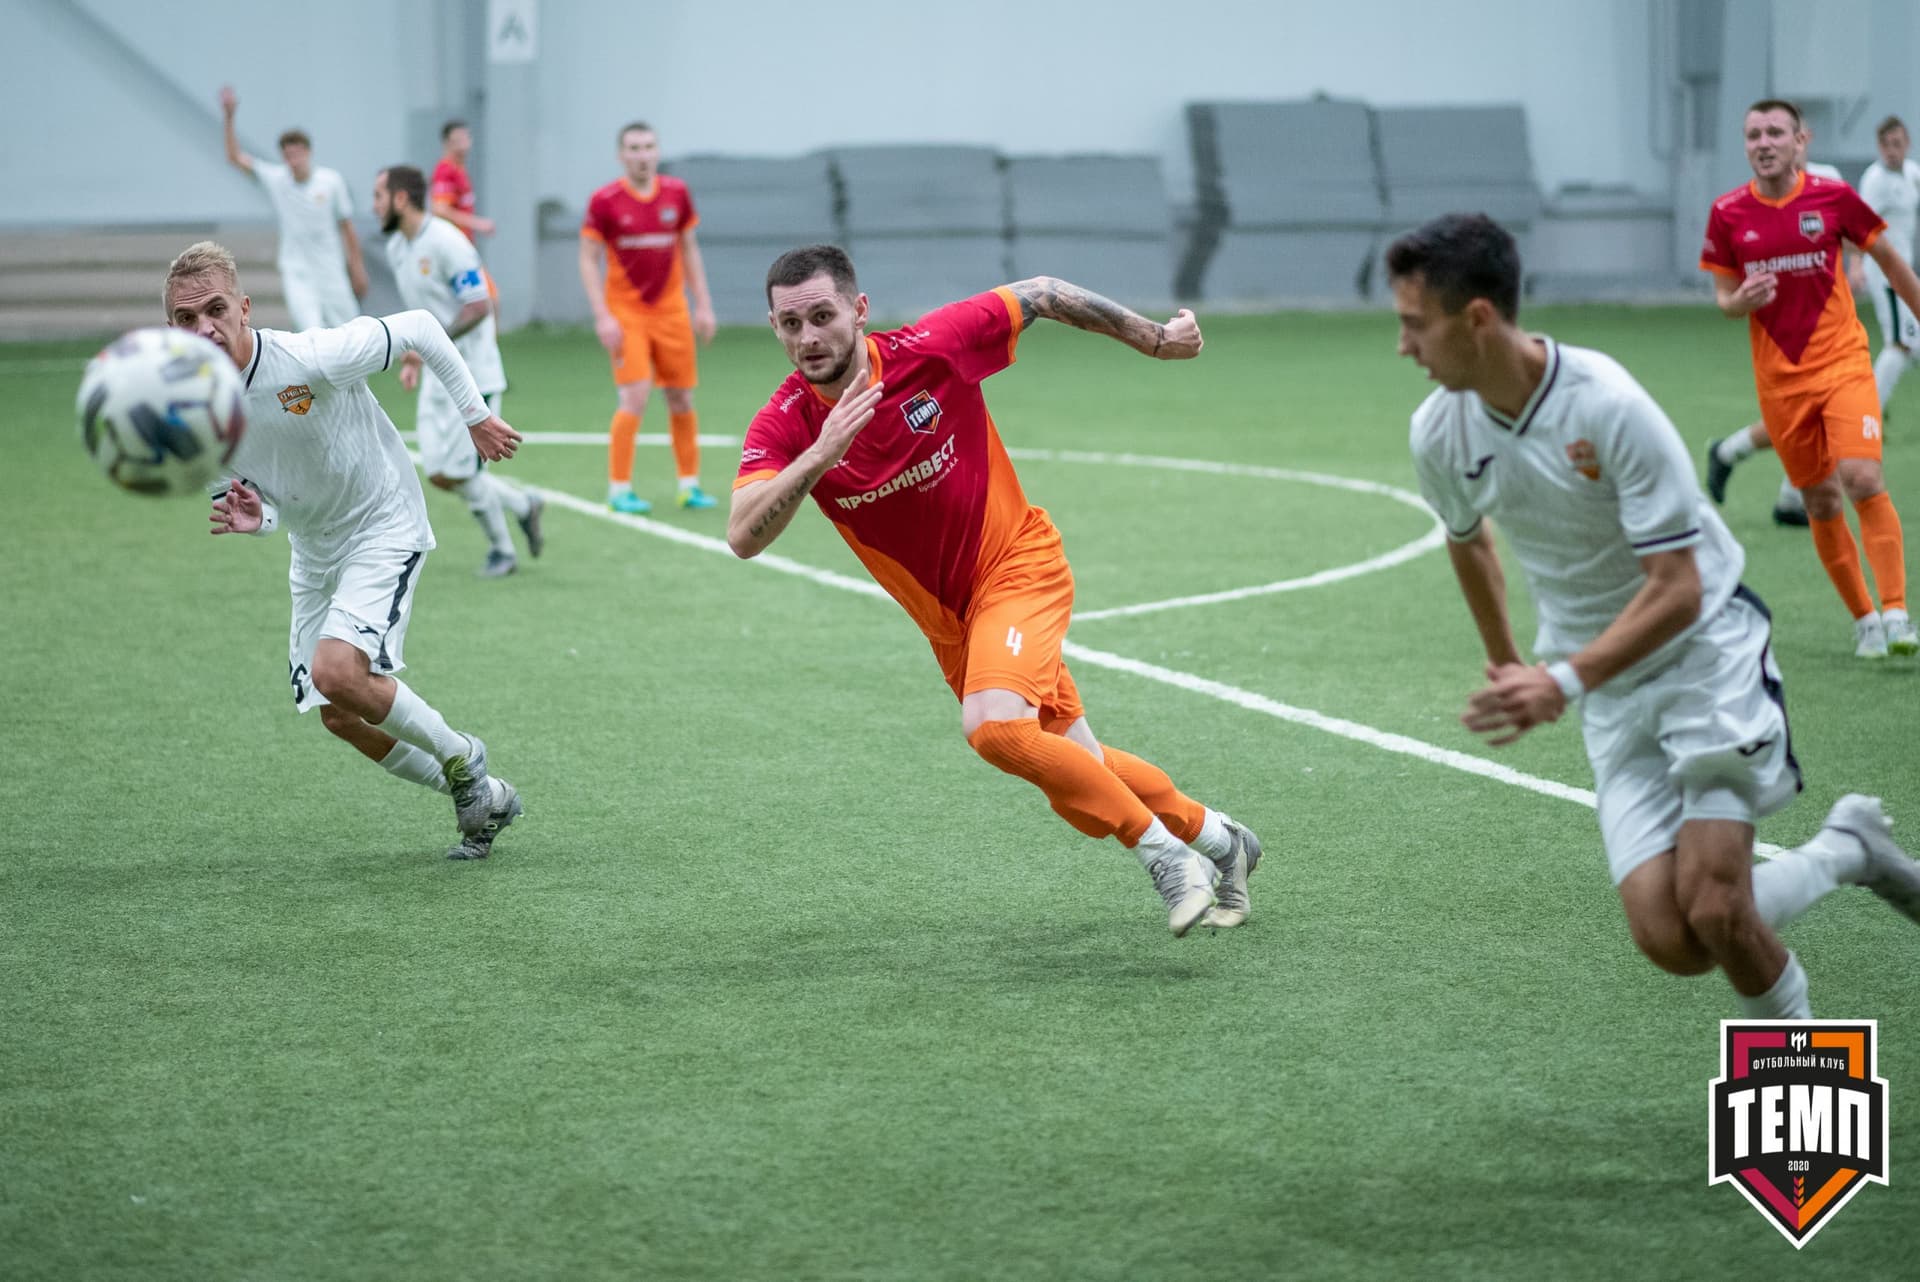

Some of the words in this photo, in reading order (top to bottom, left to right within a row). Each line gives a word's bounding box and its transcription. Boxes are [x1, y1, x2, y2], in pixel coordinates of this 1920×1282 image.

[908, 401, 938, 427] ТЕМП
[835, 433, 955, 510] ПРОДИНВЕСТ
[1006, 626, 1022, 657] 4
